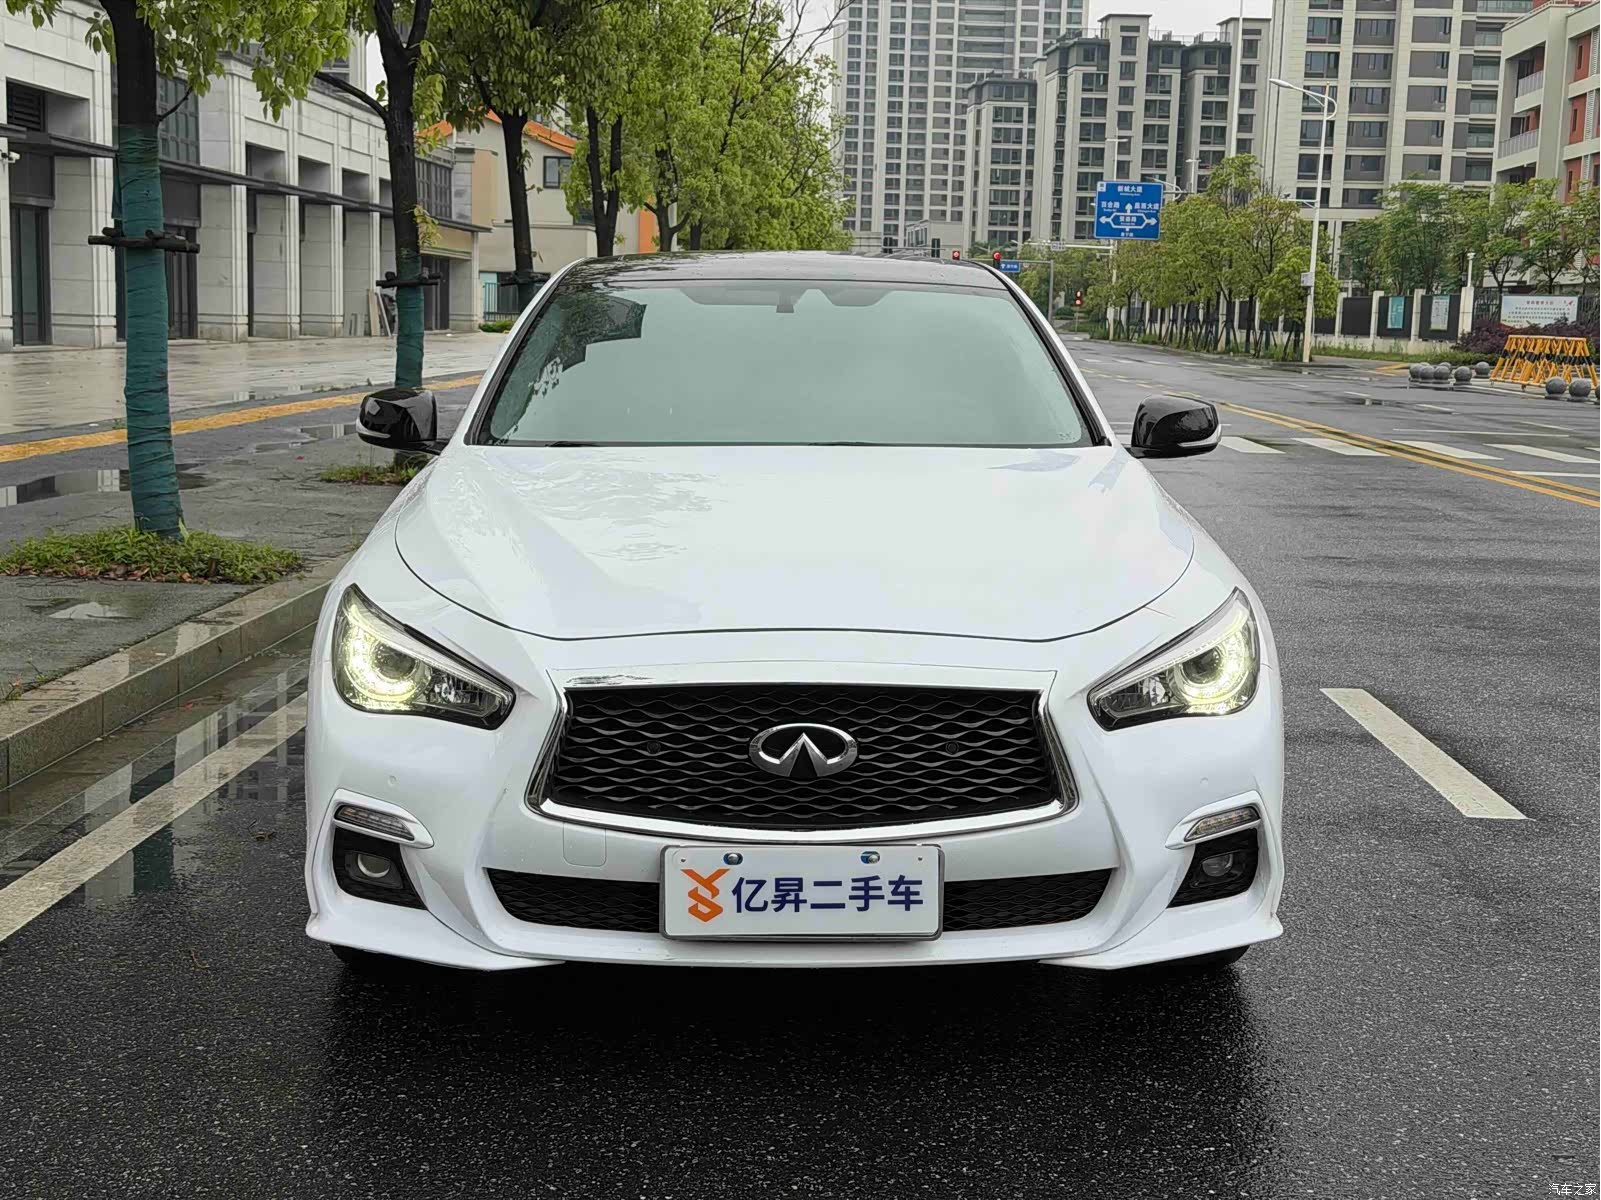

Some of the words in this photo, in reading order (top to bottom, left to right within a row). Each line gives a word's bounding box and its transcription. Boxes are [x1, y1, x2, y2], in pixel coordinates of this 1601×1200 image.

[732, 874, 924, 914] 亿昇二手车
